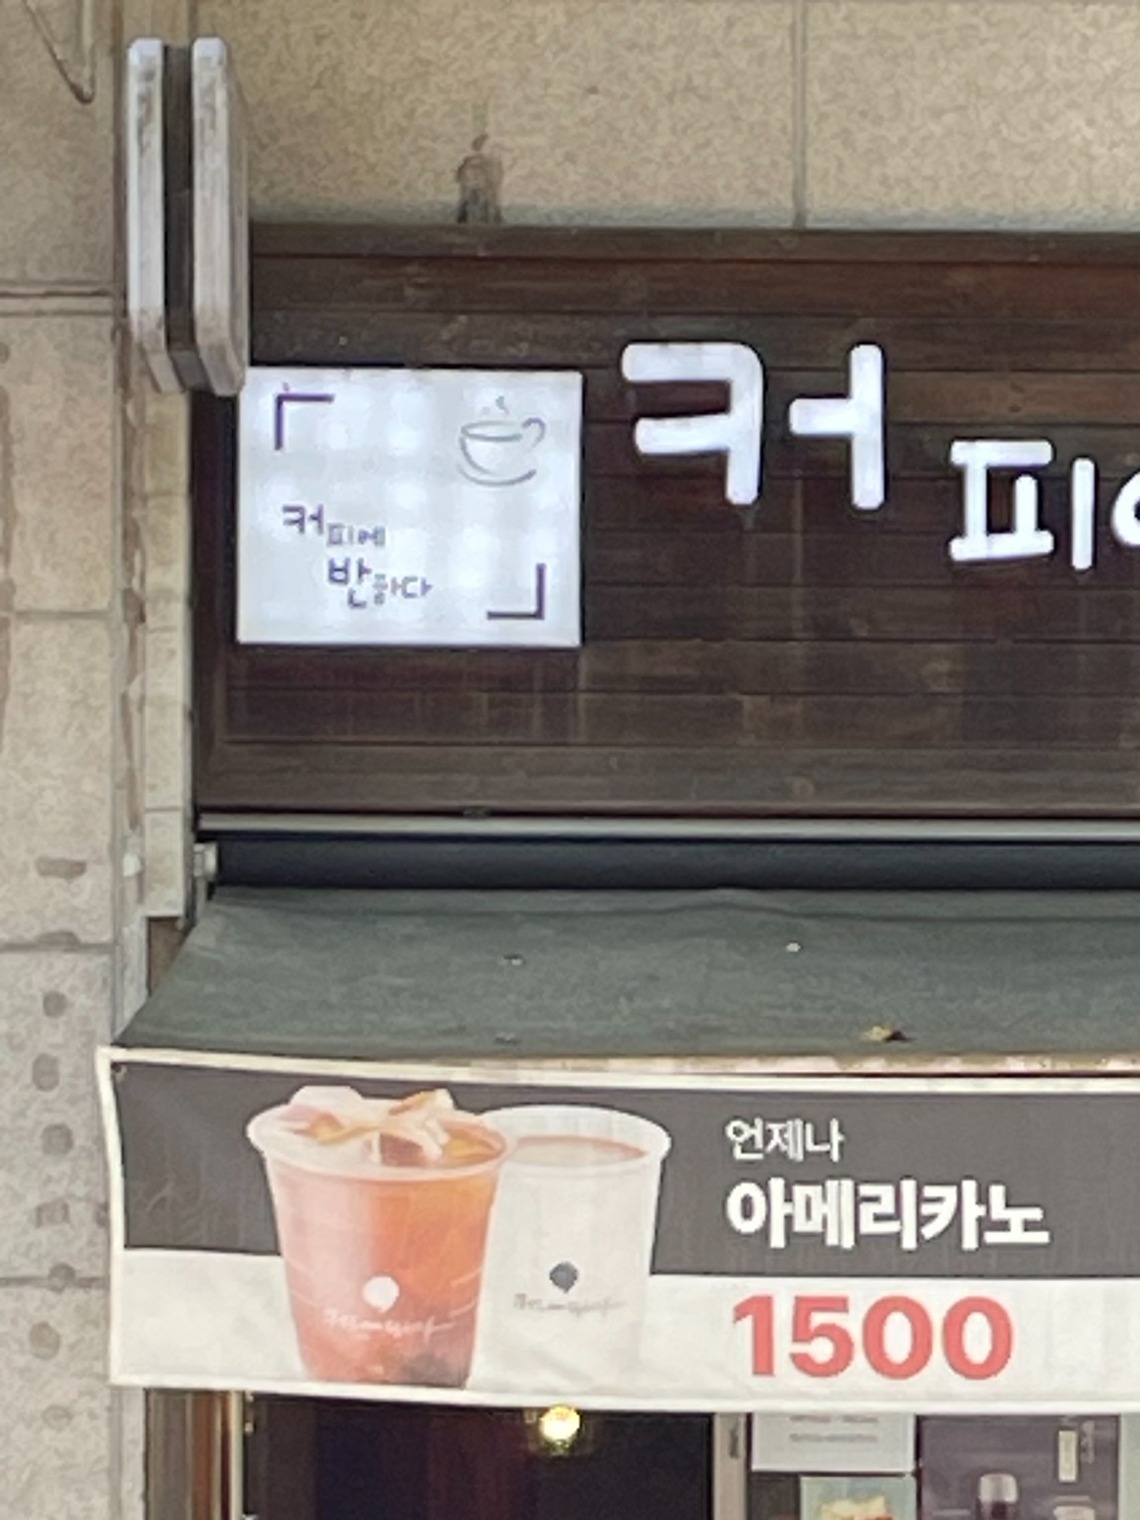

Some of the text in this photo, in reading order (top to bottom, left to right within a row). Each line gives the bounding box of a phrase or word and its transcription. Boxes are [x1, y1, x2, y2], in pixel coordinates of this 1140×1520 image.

[281, 503, 387, 547] 커피에
[327, 557, 433, 610] 반하다
[725, 1117, 846, 1163] 언제나
[726, 1176, 1051, 1252] 아메리카노
[732, 1294, 1015, 1382] 1500
